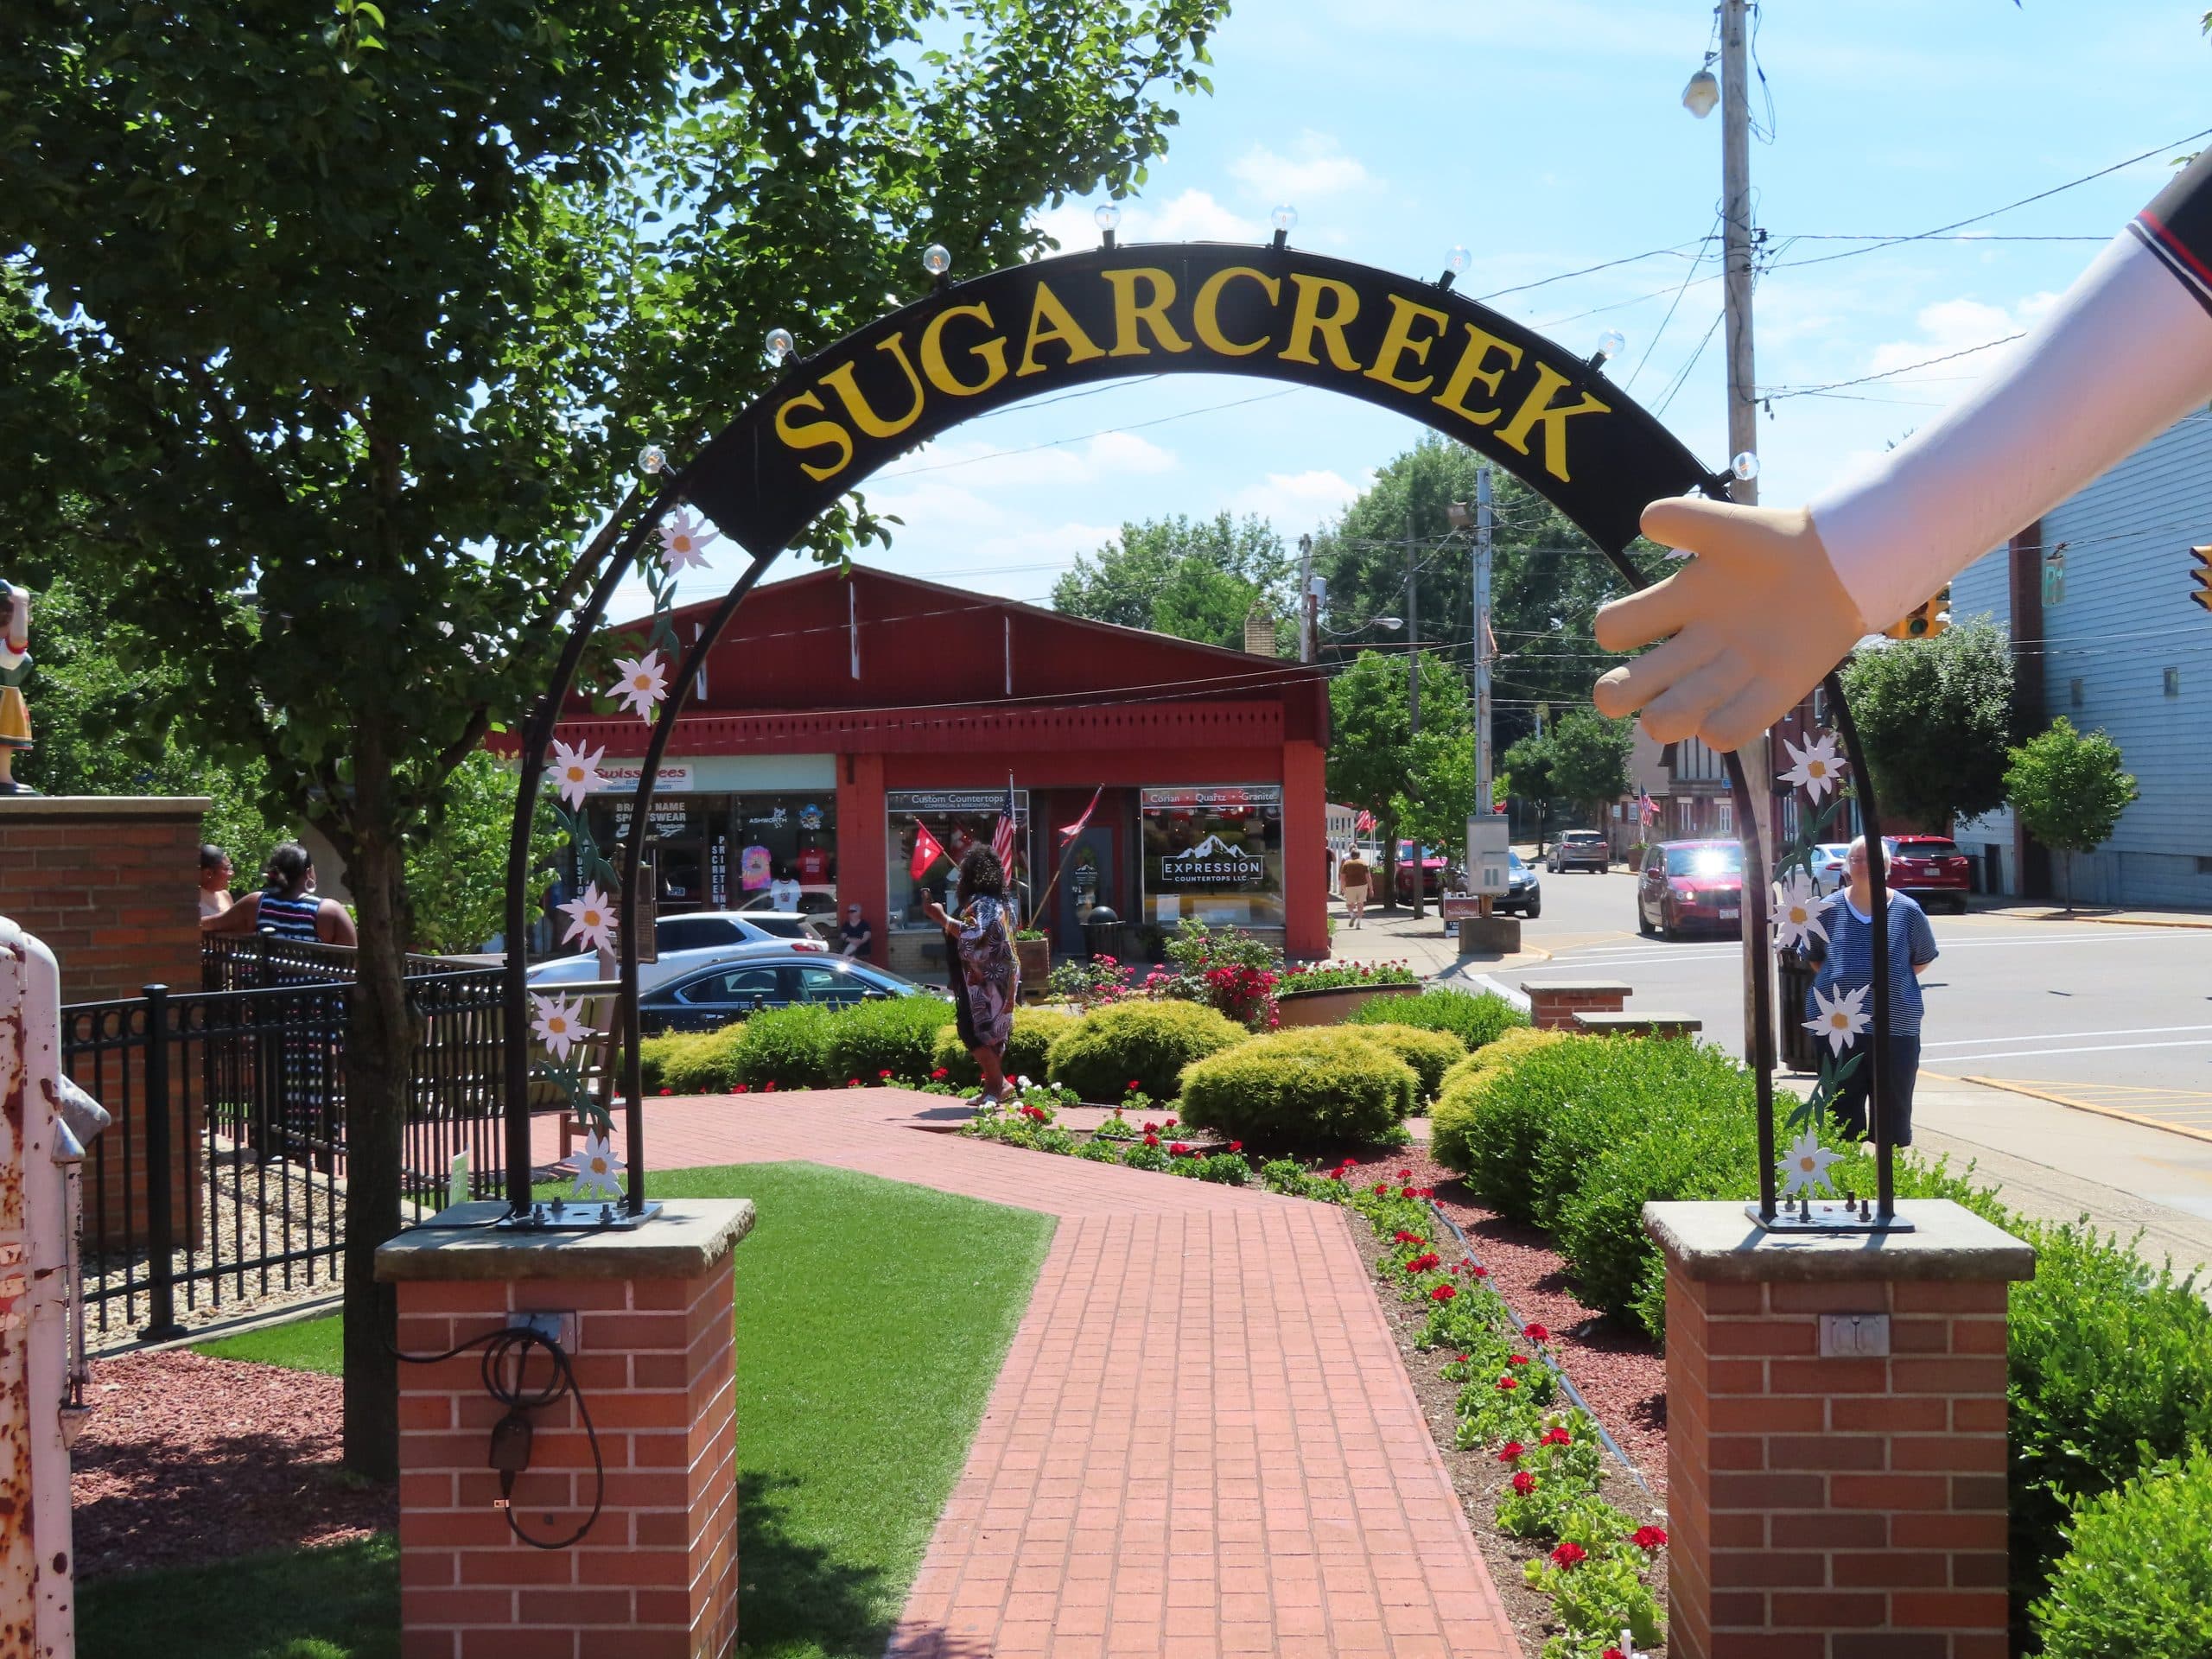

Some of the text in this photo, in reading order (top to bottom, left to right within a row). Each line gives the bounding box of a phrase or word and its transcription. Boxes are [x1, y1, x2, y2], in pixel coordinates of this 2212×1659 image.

[773, 265, 1612, 483] SUGARCREEK
[594, 767, 686, 778] Swissees
[912, 794, 1003, 804] Custom Countertops
[1150, 791, 1274, 803] Corian Quartz Granite
[655, 802, 685, 811] NAME
[615, 812, 686, 823] SPSWEAR
[1165, 862, 1260, 873] EXPRESSION
